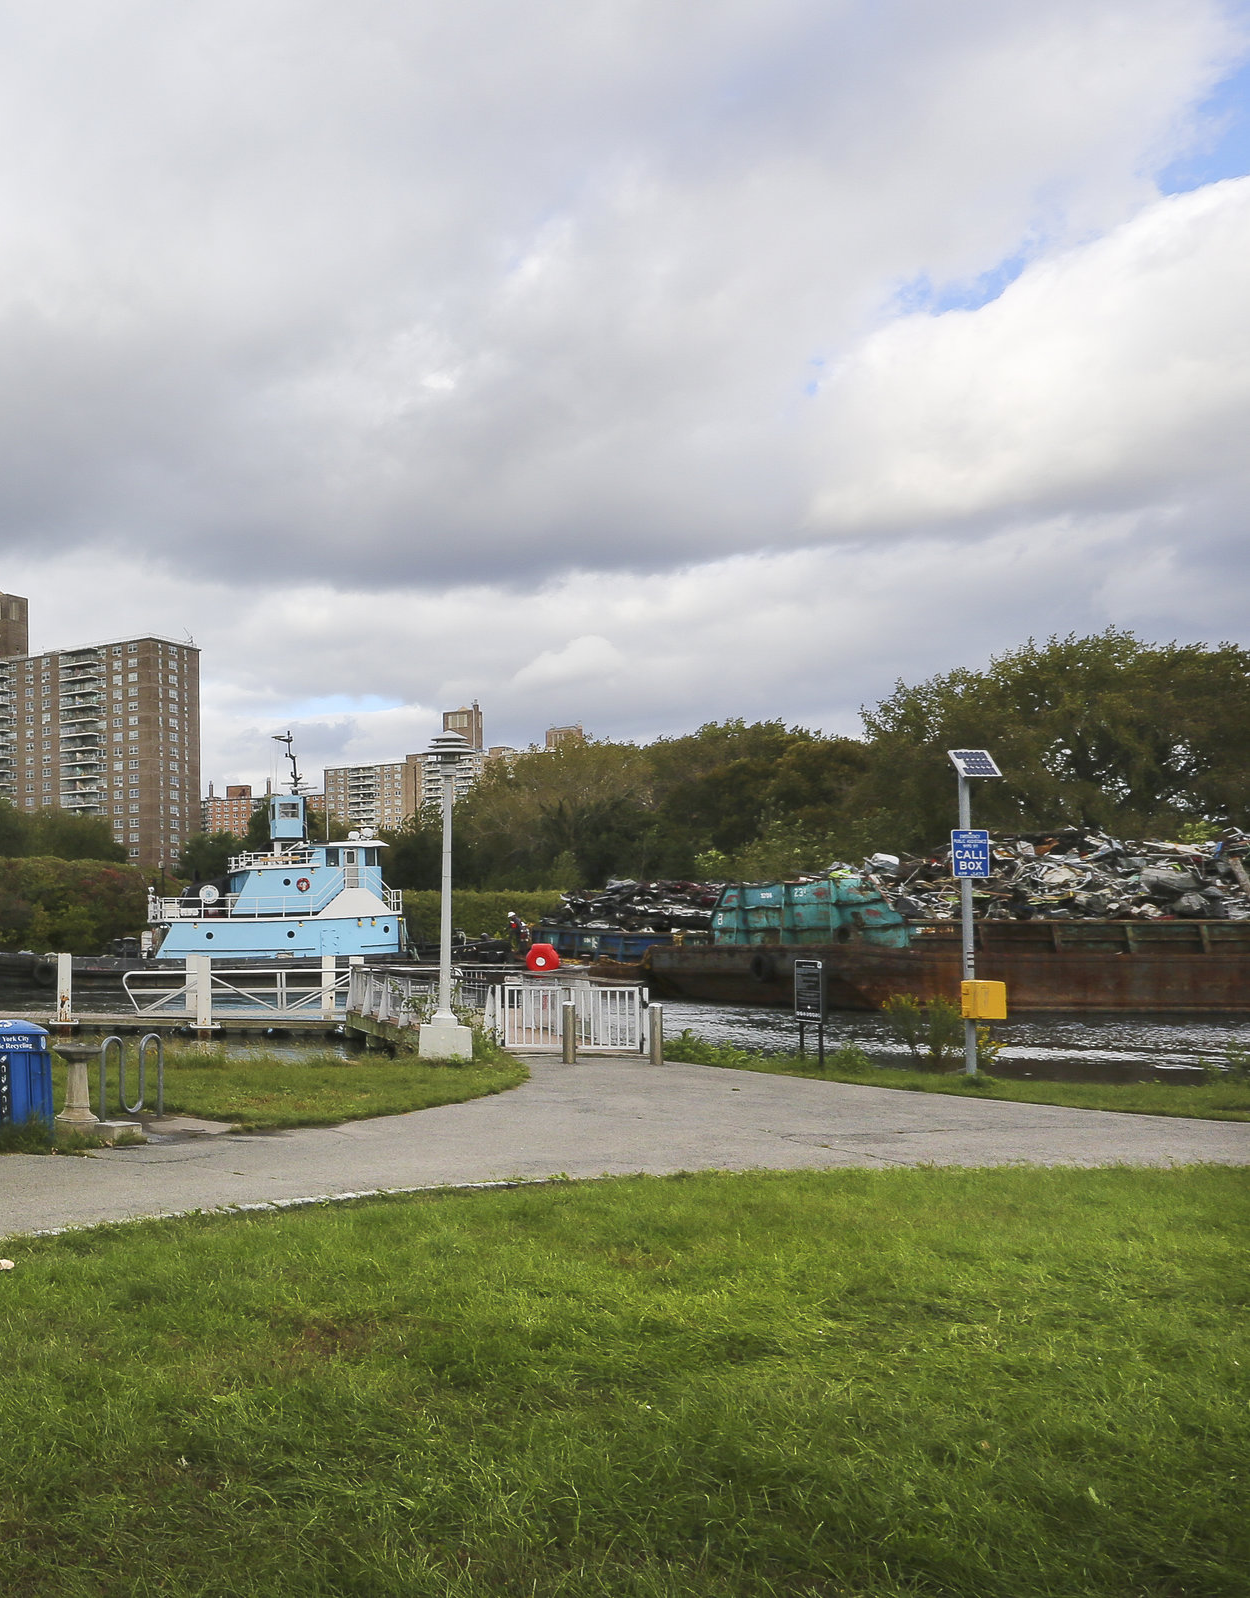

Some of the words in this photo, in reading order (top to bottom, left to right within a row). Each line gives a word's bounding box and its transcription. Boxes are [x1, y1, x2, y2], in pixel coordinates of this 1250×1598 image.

[955, 850, 987, 860] CALL
[959, 861, 983, 870] BOX
[5, 1042, 33, 1050] Recycling
